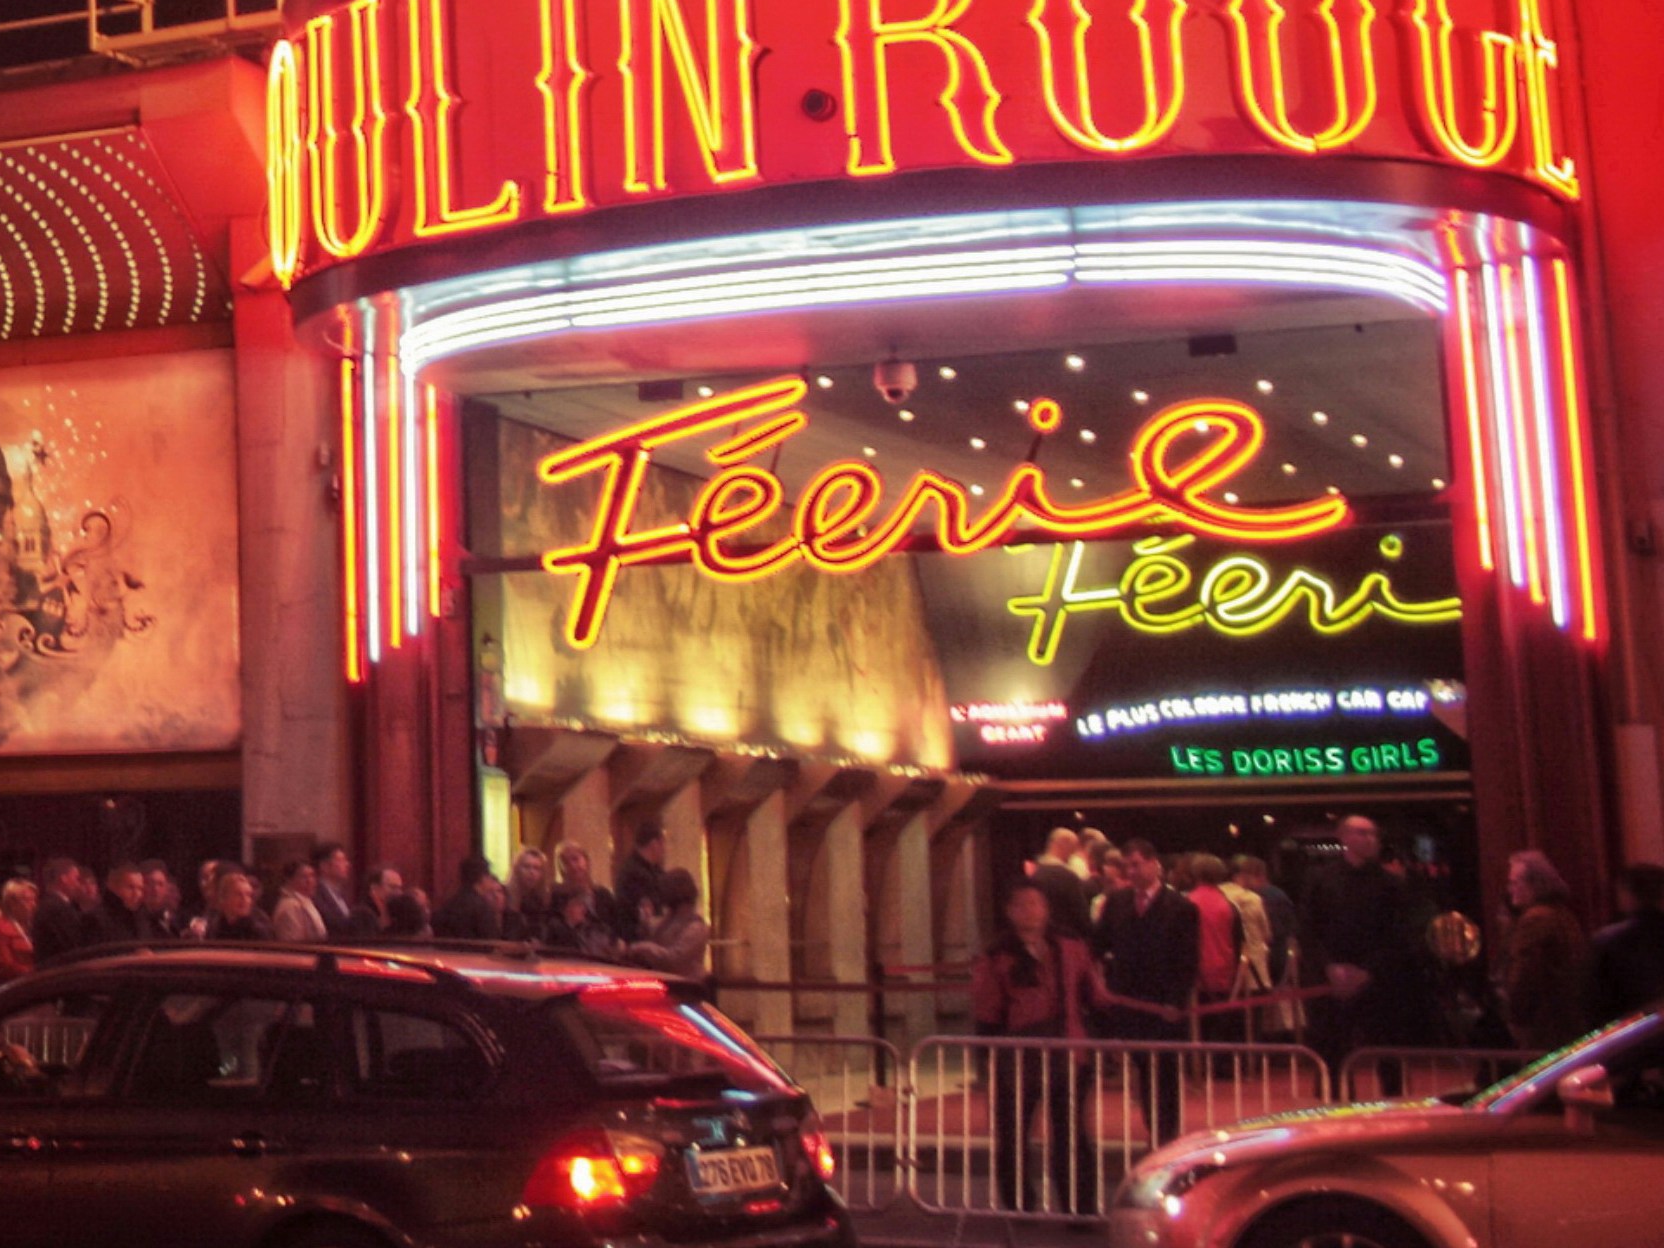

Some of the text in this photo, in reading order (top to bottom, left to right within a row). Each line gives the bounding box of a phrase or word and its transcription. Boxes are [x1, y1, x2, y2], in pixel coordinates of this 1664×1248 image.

[540, 377, 1348, 649] Féerie
[1004, 534, 1462, 665] Féeri
[1076, 715, 1105, 738] LE
[1105, 704, 1162, 735] PLUS
[1250, 689, 1332, 713] FRENCH
[1336, 687, 1383, 710] CAN
[1171, 738, 1440, 775] LES DORISS GIRLS
